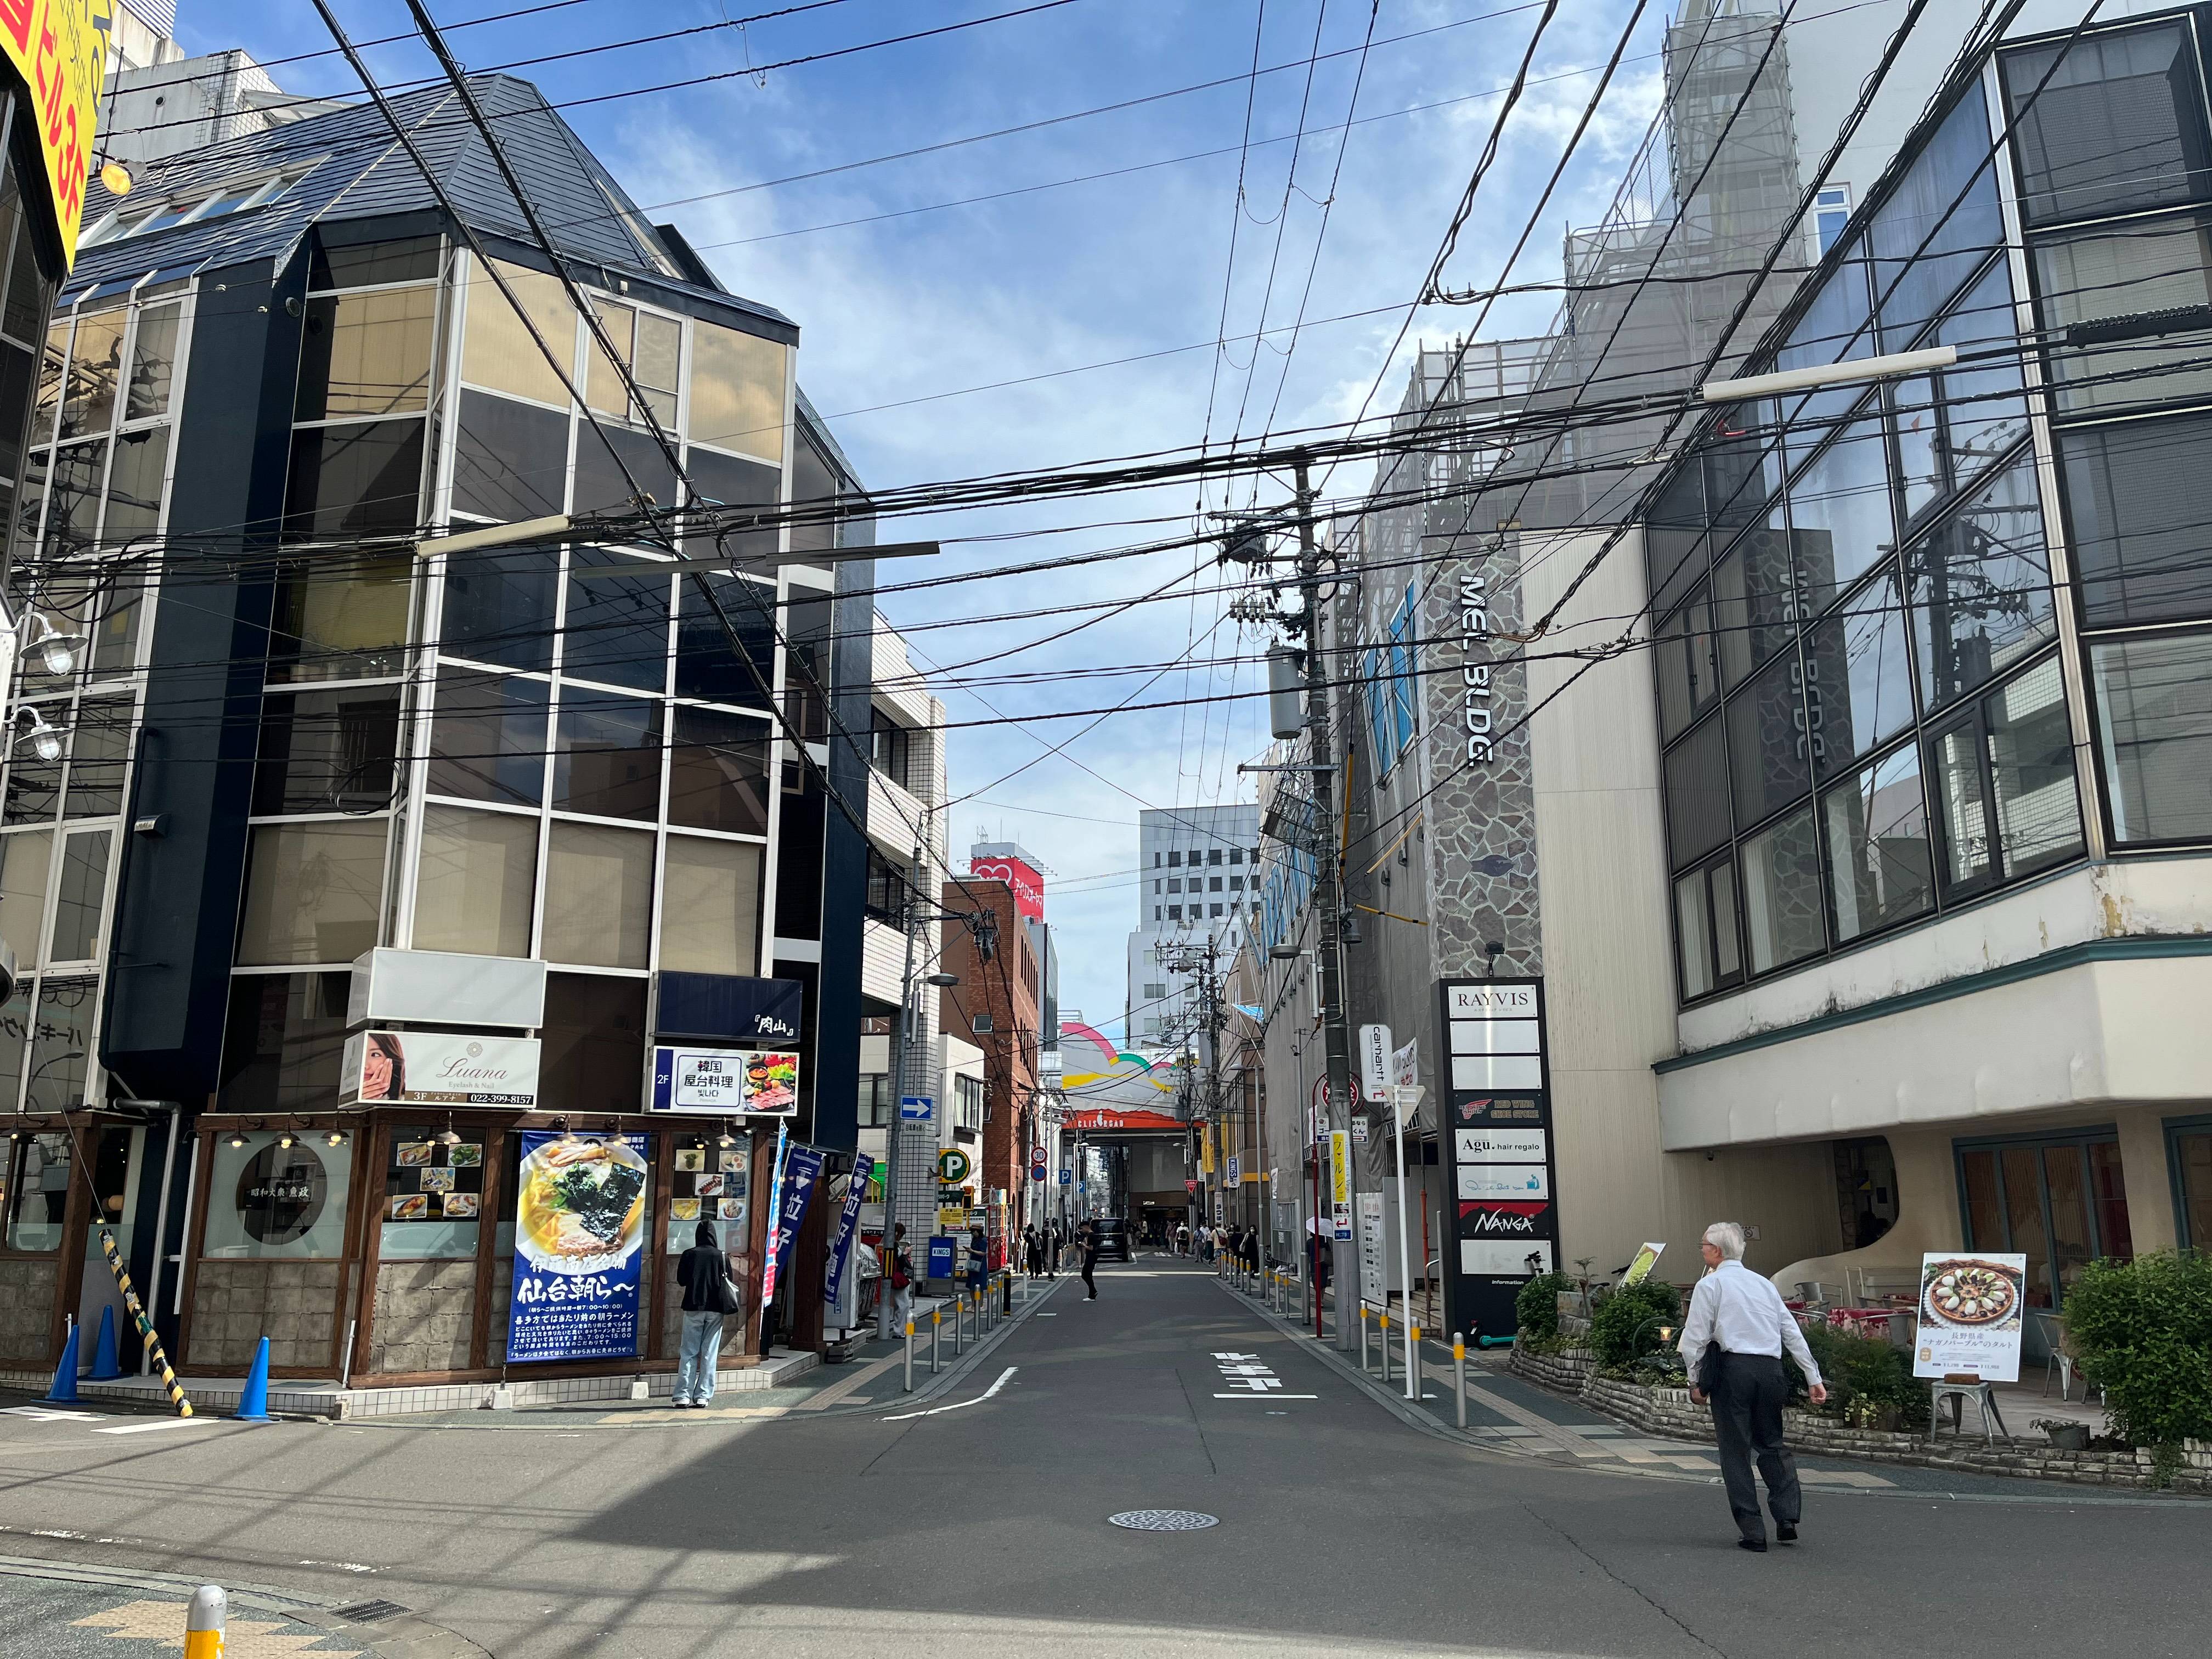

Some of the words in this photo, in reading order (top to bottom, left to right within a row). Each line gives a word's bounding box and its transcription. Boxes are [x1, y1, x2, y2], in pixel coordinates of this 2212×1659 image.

[1459, 574, 1488, 652] MEL
[1457, 992, 1528, 1007] RAYVIS
[1373, 1026, 1385, 1081] carhartt
[436, 1057, 509, 1080] Luana
[697, 1060, 722, 1073] 韓国
[657, 1074, 669, 1084] 2F
[685, 1075, 733, 1088] 屋台料理
[413, 1091, 427, 1101] 3F
[470, 1094, 532, 1104] 022-399-8157
[698, 1088, 720, 1097] 빛나다
[1494, 1099, 1511, 1108] RED
[1511, 1099, 1535, 1108] WING
[1491, 1110, 1511, 1118] SHOE
[1513, 1110, 1539, 1118] STORE
[1463, 1138, 1495, 1153] Agu.
[946, 1156, 963, 1177] P
[1062, 1171, 1069, 1183] P
[1474, 1207, 1534, 1234] NANGA
